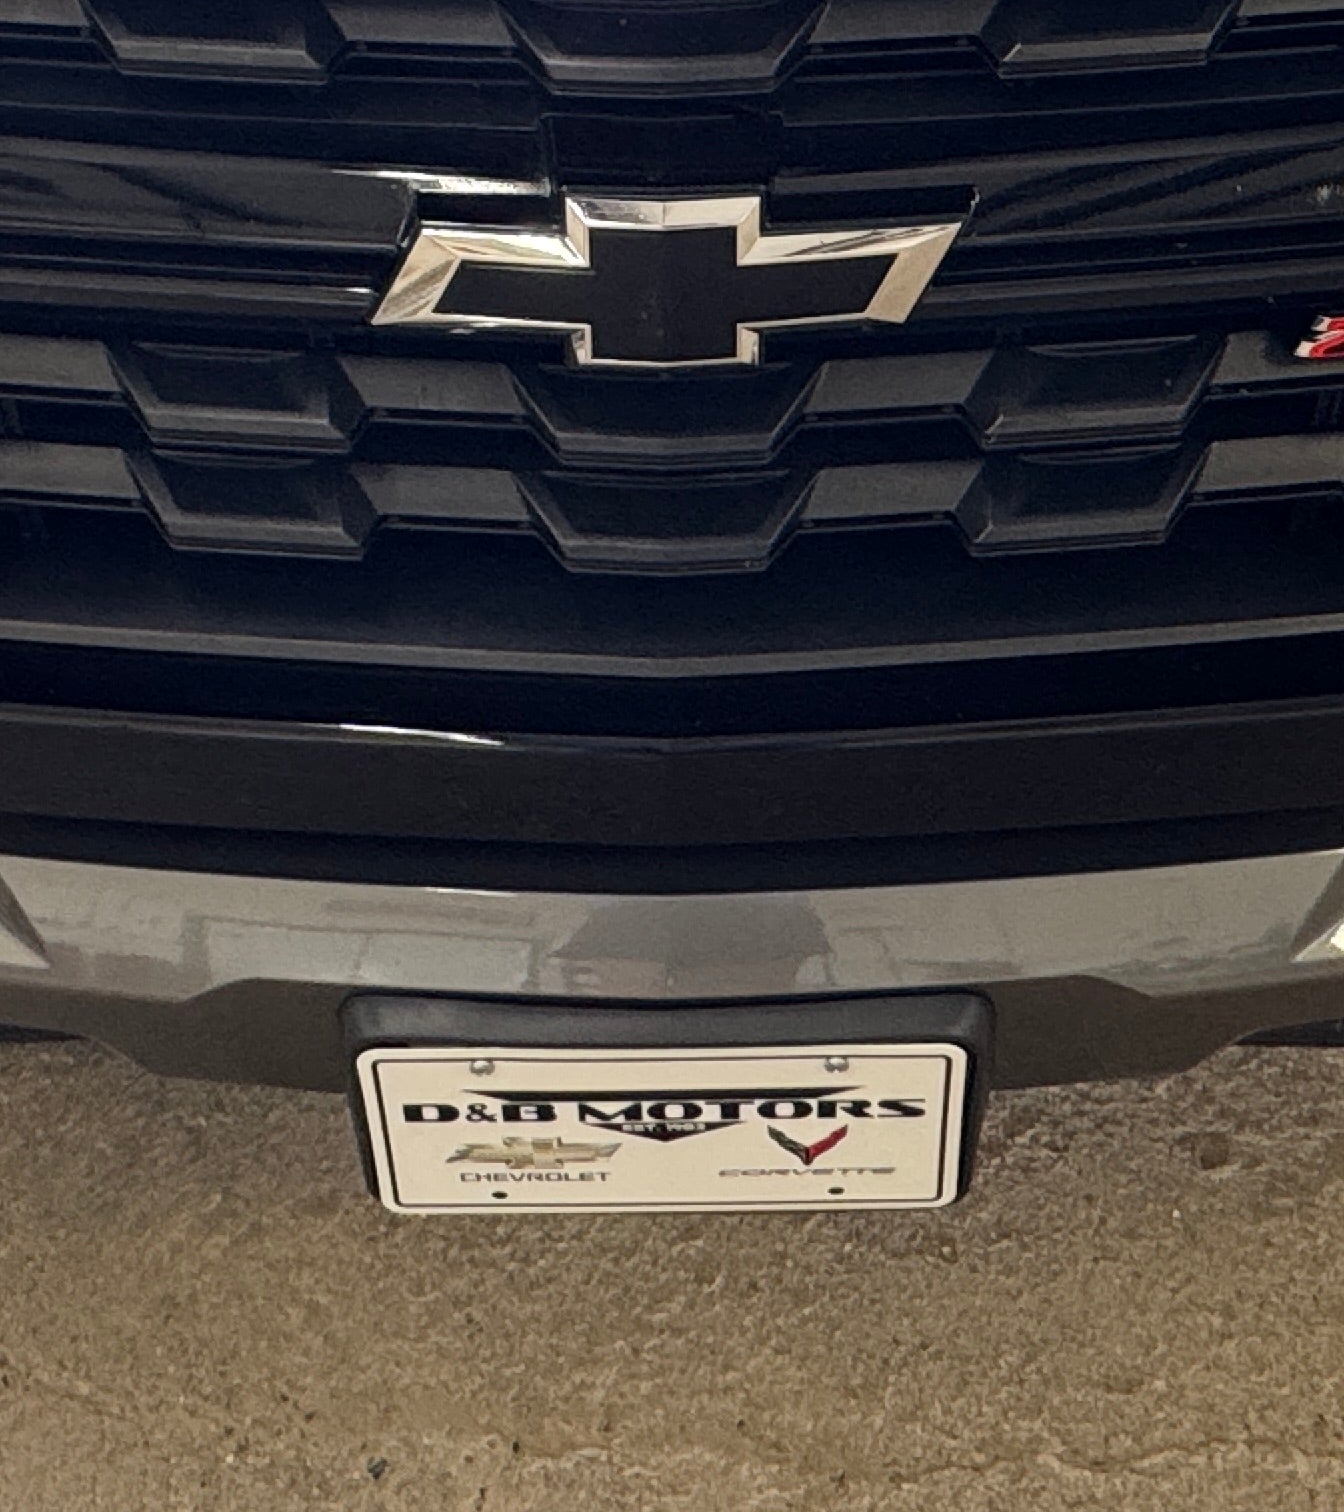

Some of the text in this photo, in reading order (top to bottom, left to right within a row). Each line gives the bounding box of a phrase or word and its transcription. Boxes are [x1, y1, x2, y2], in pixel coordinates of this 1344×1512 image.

[403, 1098, 926, 1123] D&B MOTORS
[459, 1171, 611, 1182] CHEVROLET
